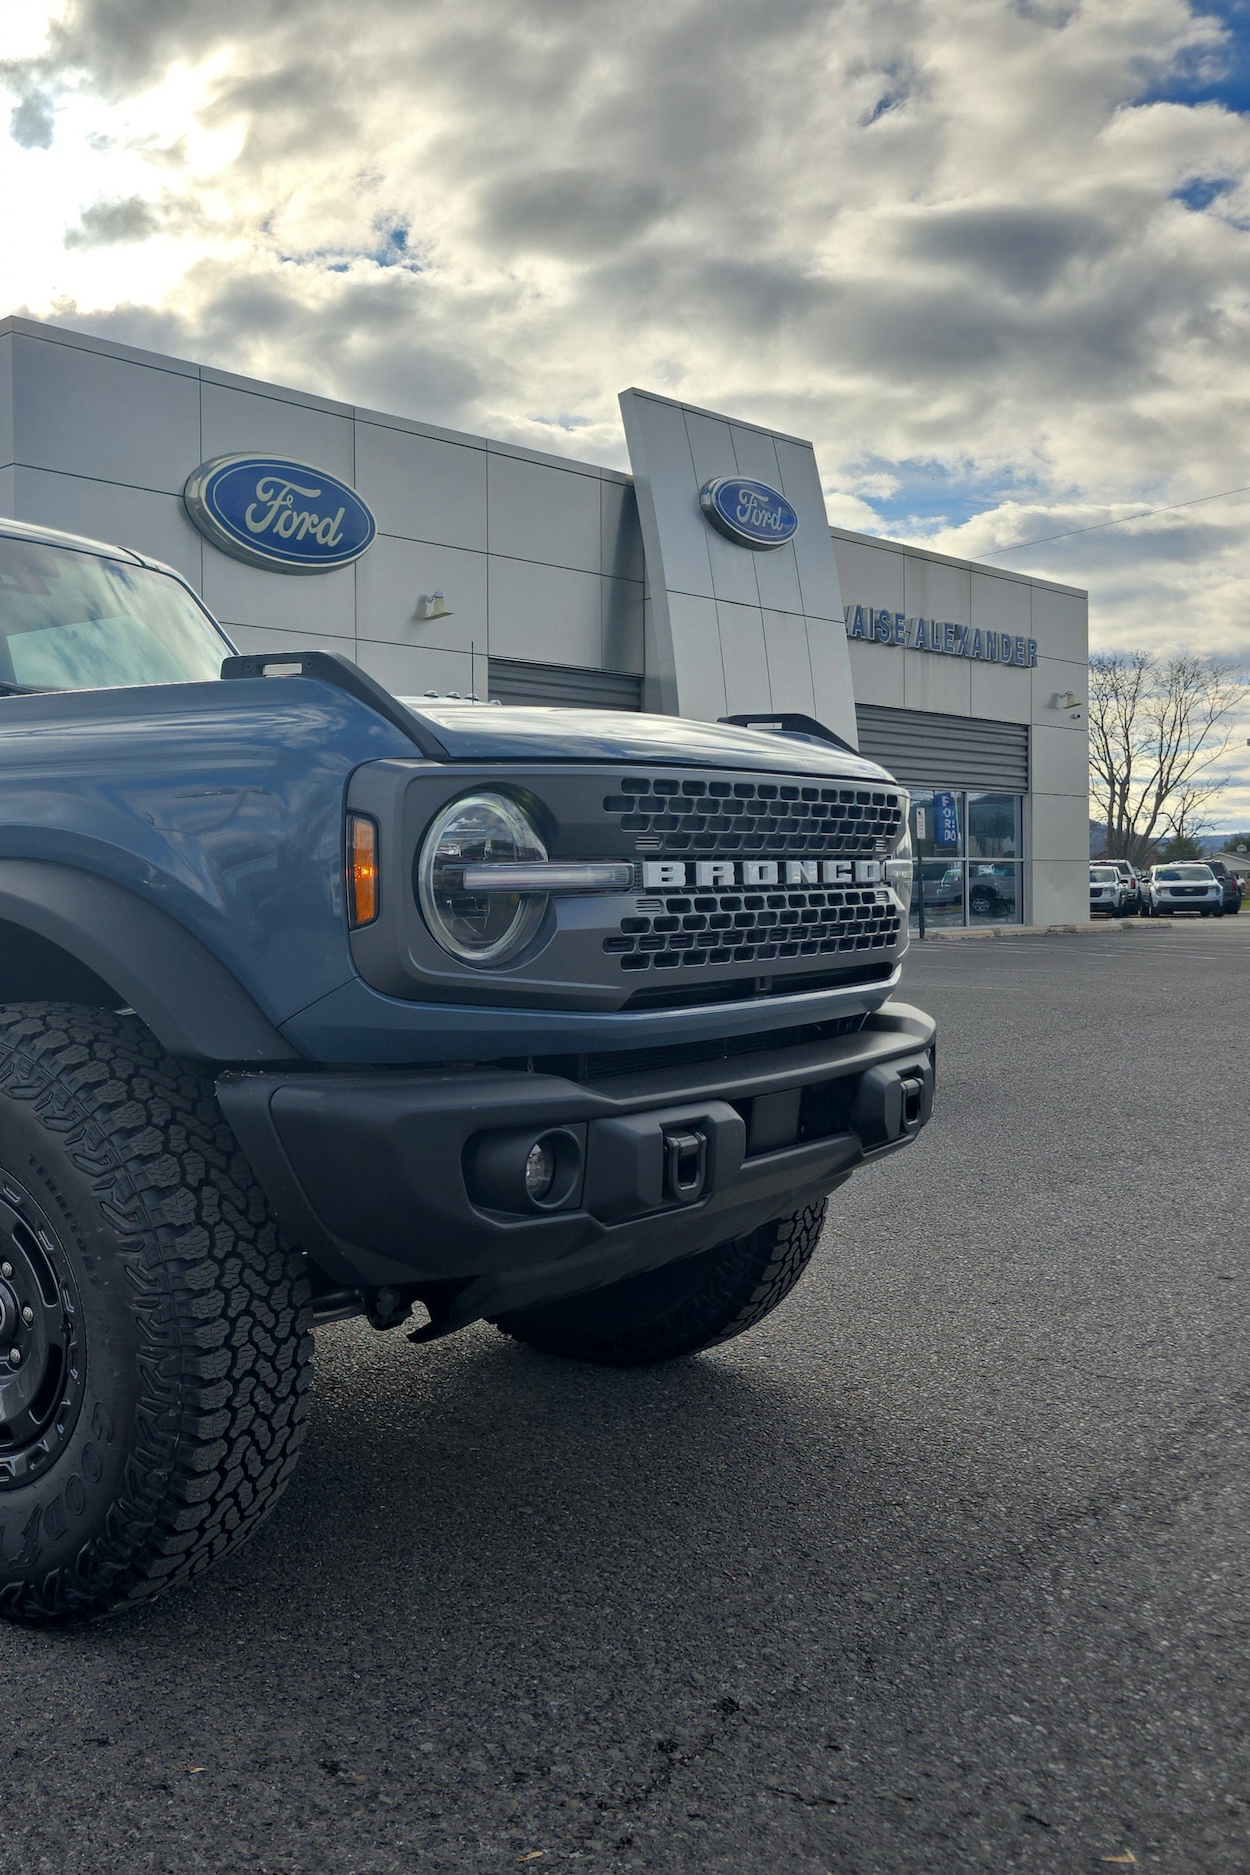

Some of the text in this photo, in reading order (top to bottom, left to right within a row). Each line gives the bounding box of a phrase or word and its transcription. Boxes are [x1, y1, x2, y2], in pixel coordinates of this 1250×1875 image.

[245, 476, 346, 547] Ford
[736, 489, 784, 531] Ford
[845, 604, 1038, 669] AISE ALEXANDER
[642, 860, 881, 889] BRONCO
